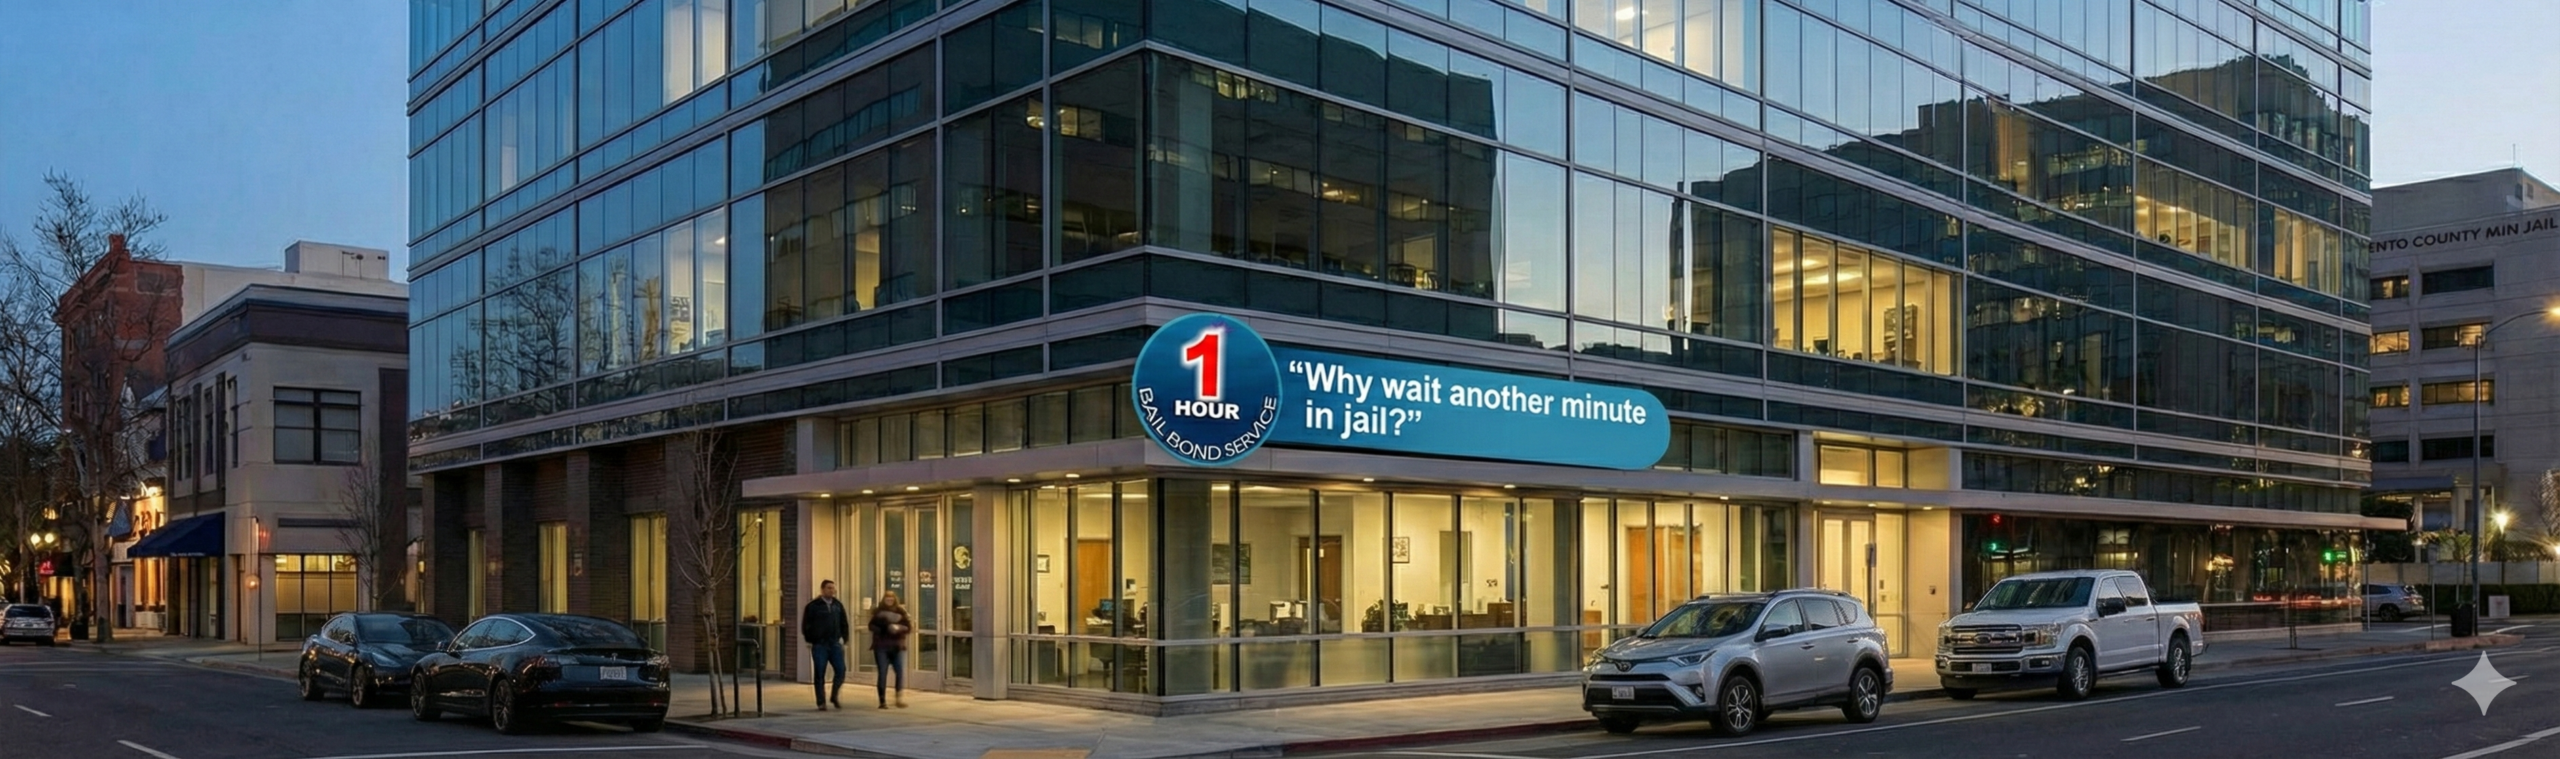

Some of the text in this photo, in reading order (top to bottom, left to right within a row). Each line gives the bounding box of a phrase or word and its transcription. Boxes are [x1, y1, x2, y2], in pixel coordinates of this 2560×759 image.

[2413, 229, 2481, 247] COUNTY
[2486, 224, 2519, 239] MIN
[2523, 217, 2558, 234] JAIL
[1184, 331, 1221, 399] 1
[1174, 400, 1240, 420] HOUR
[1306, 400, 1334, 429] in
[1382, 375, 1441, 404] wait
[1450, 384, 1555, 415] another
[1562, 394, 1647, 425] minute
[1139, 387, 1277, 460] BAIL BOND SERVICE
